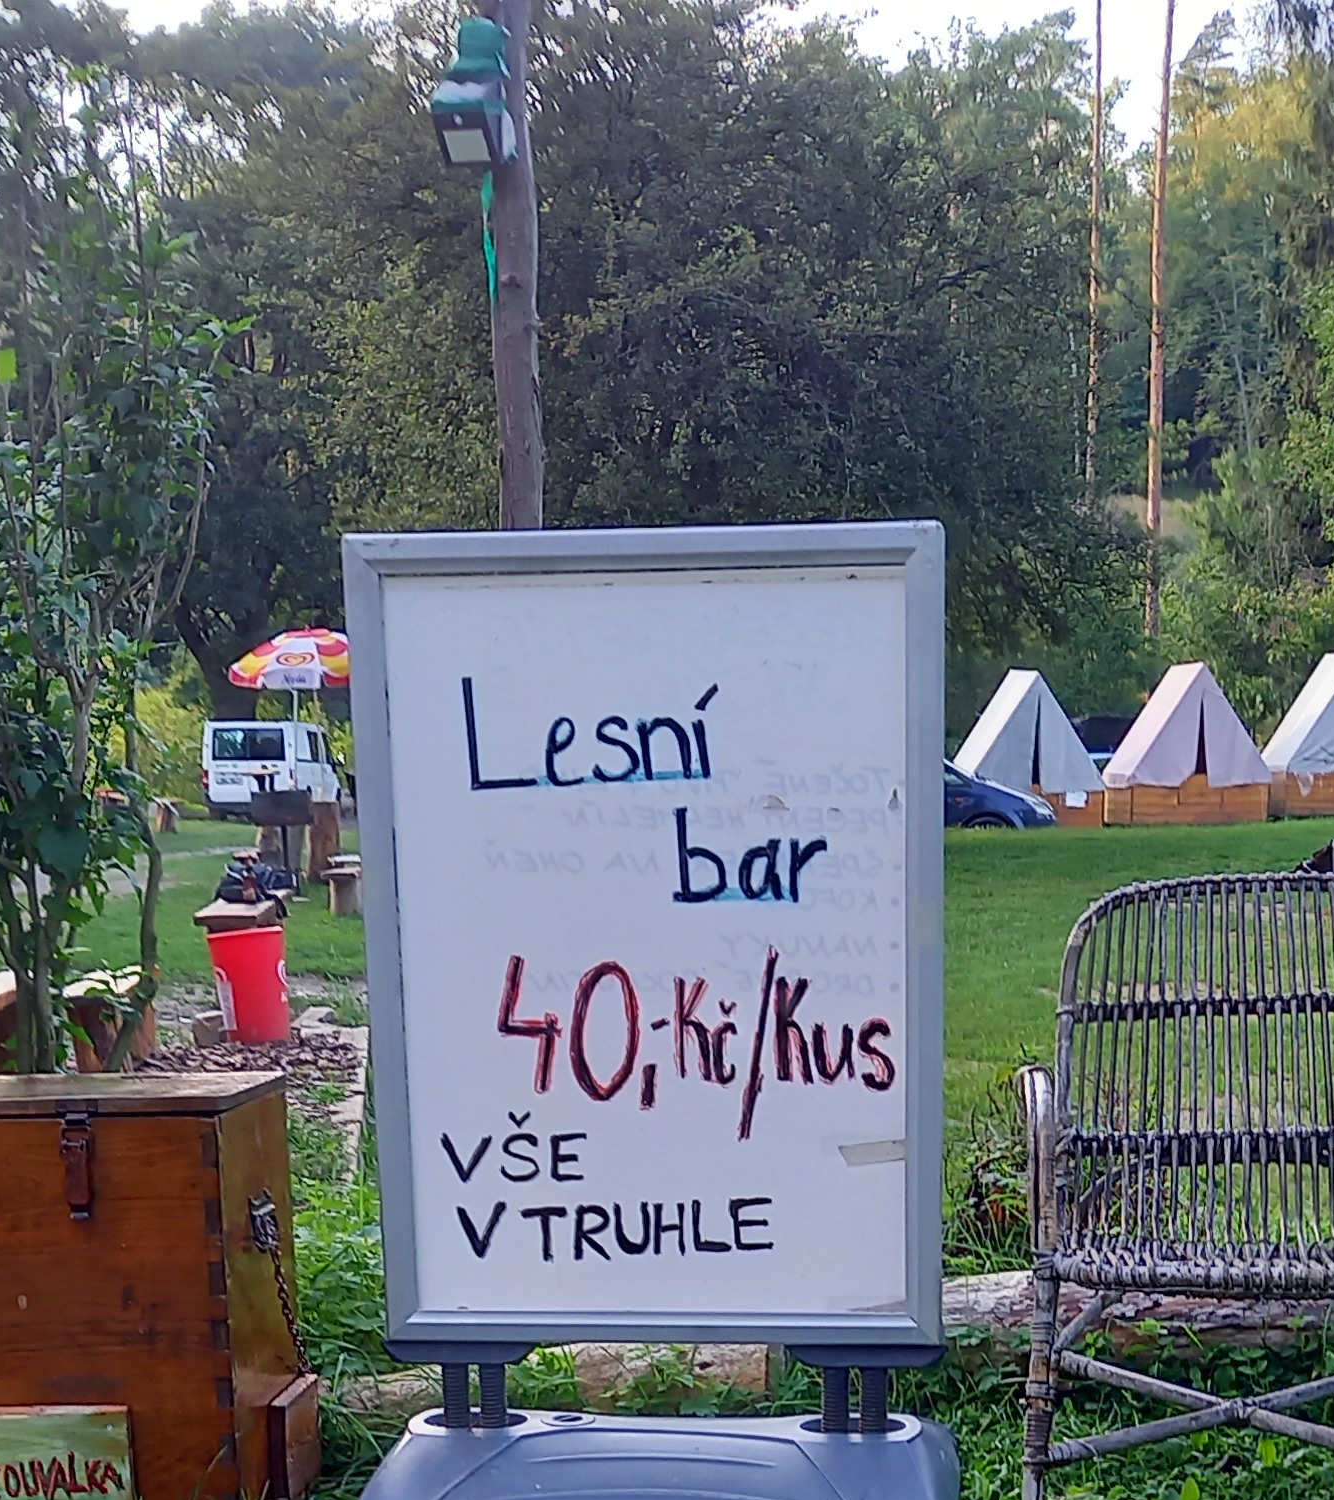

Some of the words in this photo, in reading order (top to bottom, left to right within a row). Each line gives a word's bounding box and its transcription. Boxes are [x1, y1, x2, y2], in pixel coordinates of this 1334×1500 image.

[462, 677, 719, 791] Lesní
[673, 806, 827, 903] bar
[441, 1111, 588, 1184] VŠE
[457, 1202, 508, 1260] V
[523, 1197, 775, 1263] TRUHLE
